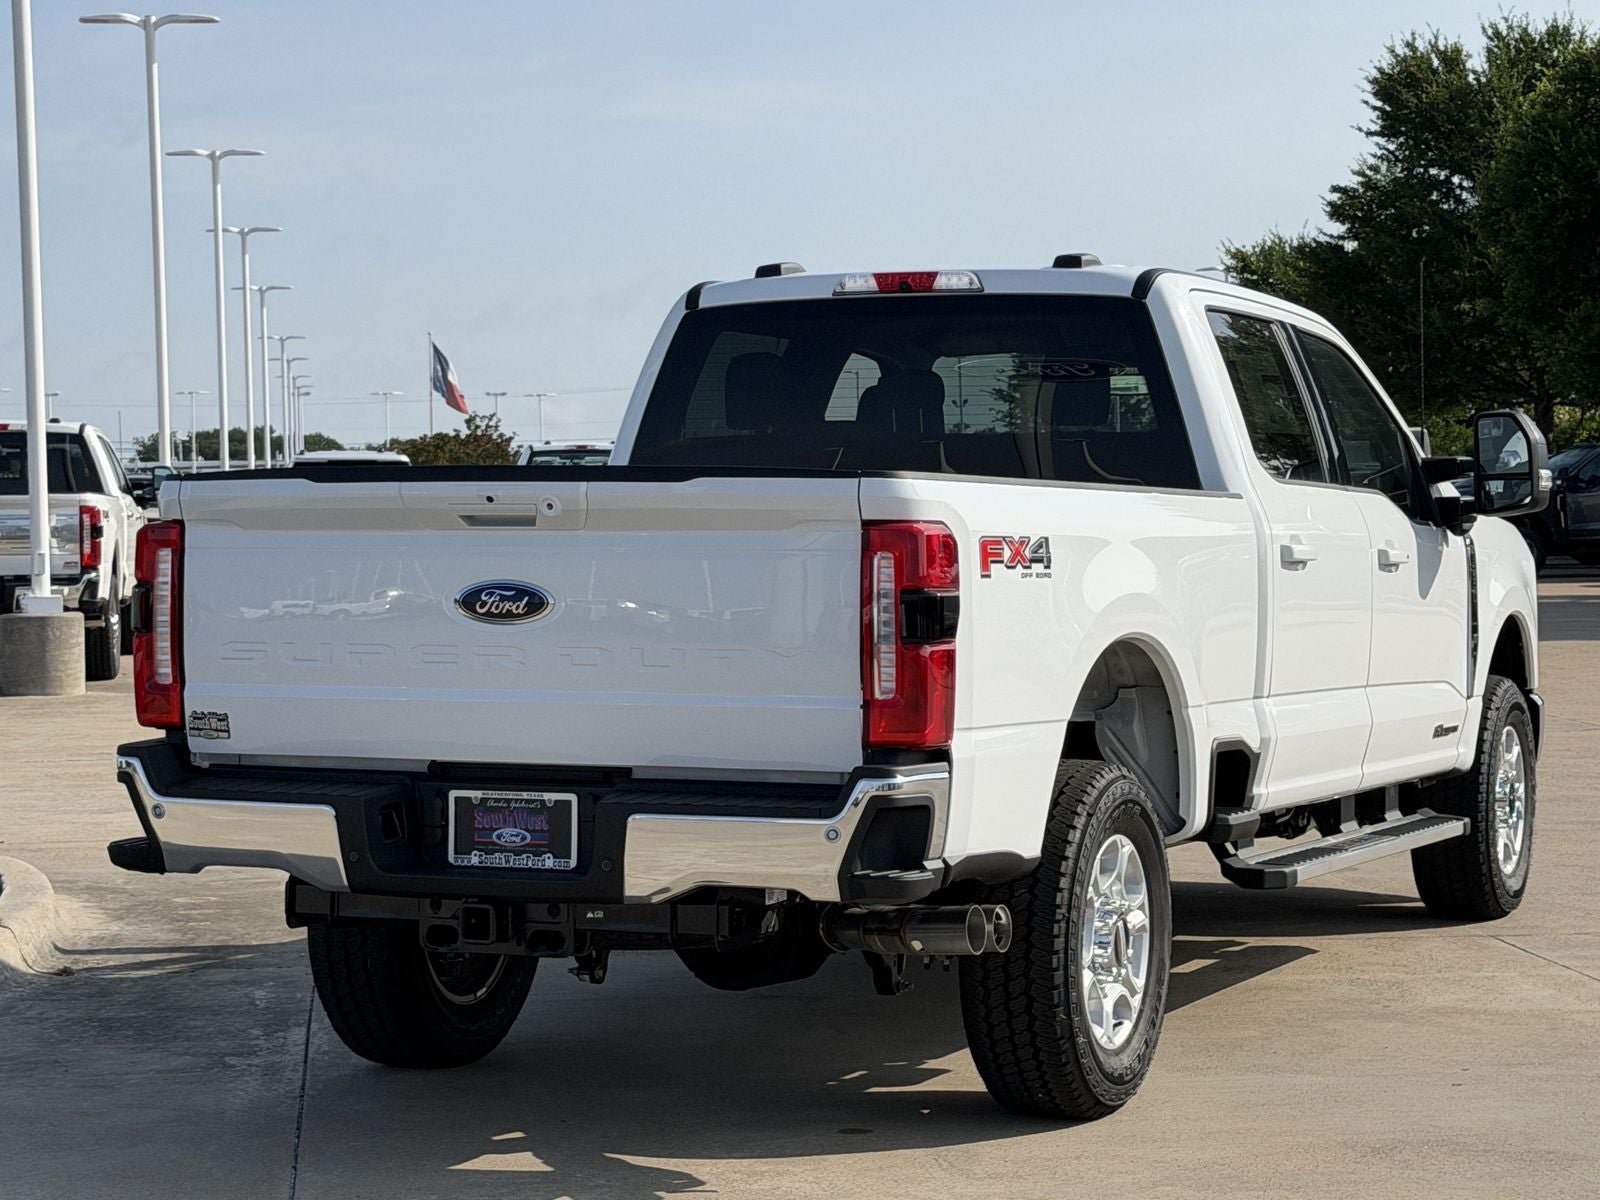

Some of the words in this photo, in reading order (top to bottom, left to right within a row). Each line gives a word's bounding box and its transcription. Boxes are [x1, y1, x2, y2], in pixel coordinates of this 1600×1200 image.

[979, 535, 1051, 578] FX4
[475, 588, 529, 615] Ford
[221, 640, 528, 669] SUPER
[500, 830, 523, 843] Ford
[453, 854, 571, 869] www.SouthWestFord.com
